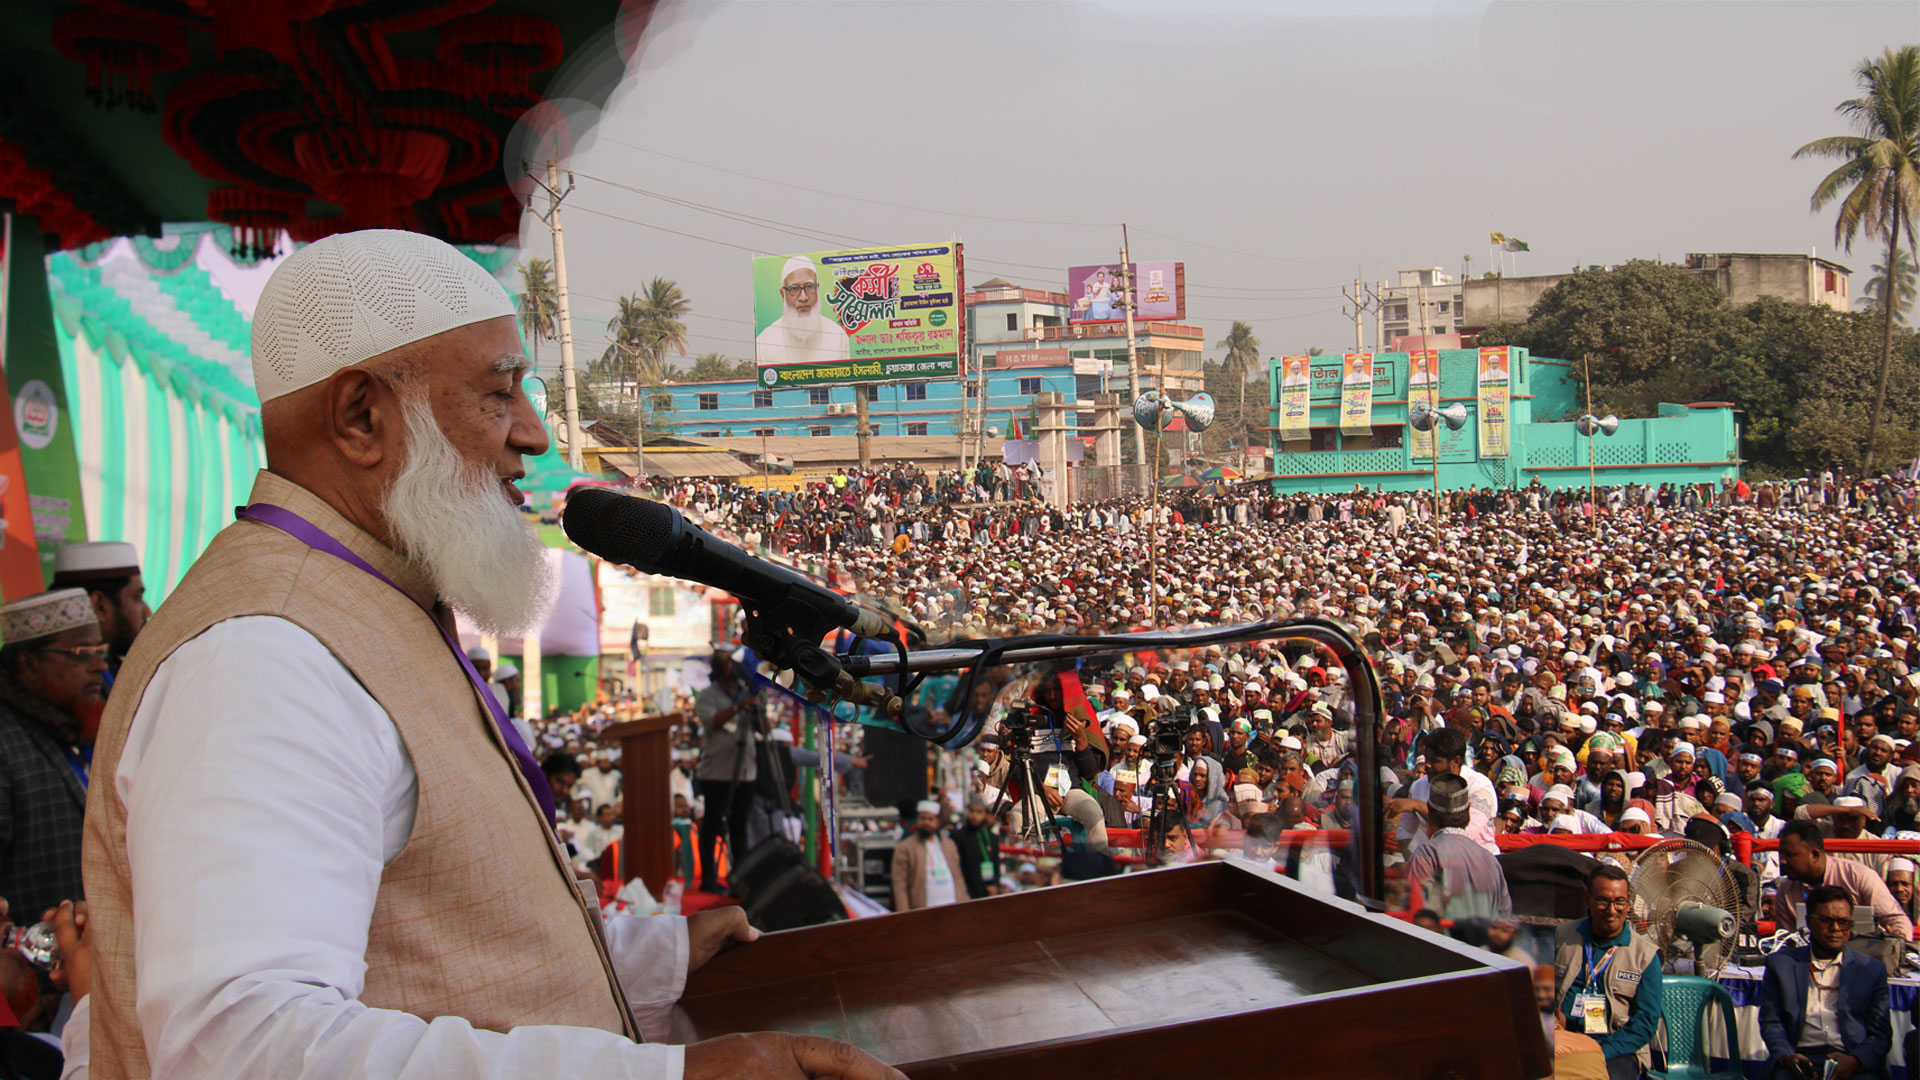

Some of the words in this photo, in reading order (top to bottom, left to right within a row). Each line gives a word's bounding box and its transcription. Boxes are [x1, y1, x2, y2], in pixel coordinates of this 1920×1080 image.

[919, 265, 932, 274] ১৭
[852, 263, 899, 298] কর্মী
[826, 280, 902, 329] সম্মেলন
[854, 334, 877, 345] জনাব
[895, 329, 924, 344] শফিকুর
[927, 328, 953, 342] রহমান
[1006, 354, 1038, 362] HATIM
[779, 370, 814, 382] বাংলাদেশ
[816, 367, 852, 380] জামায়াতে
[852, 362, 884, 378] ইসলামী,
[916, 362, 936, 372] জেলা
[937, 360, 952, 370] শাখা
